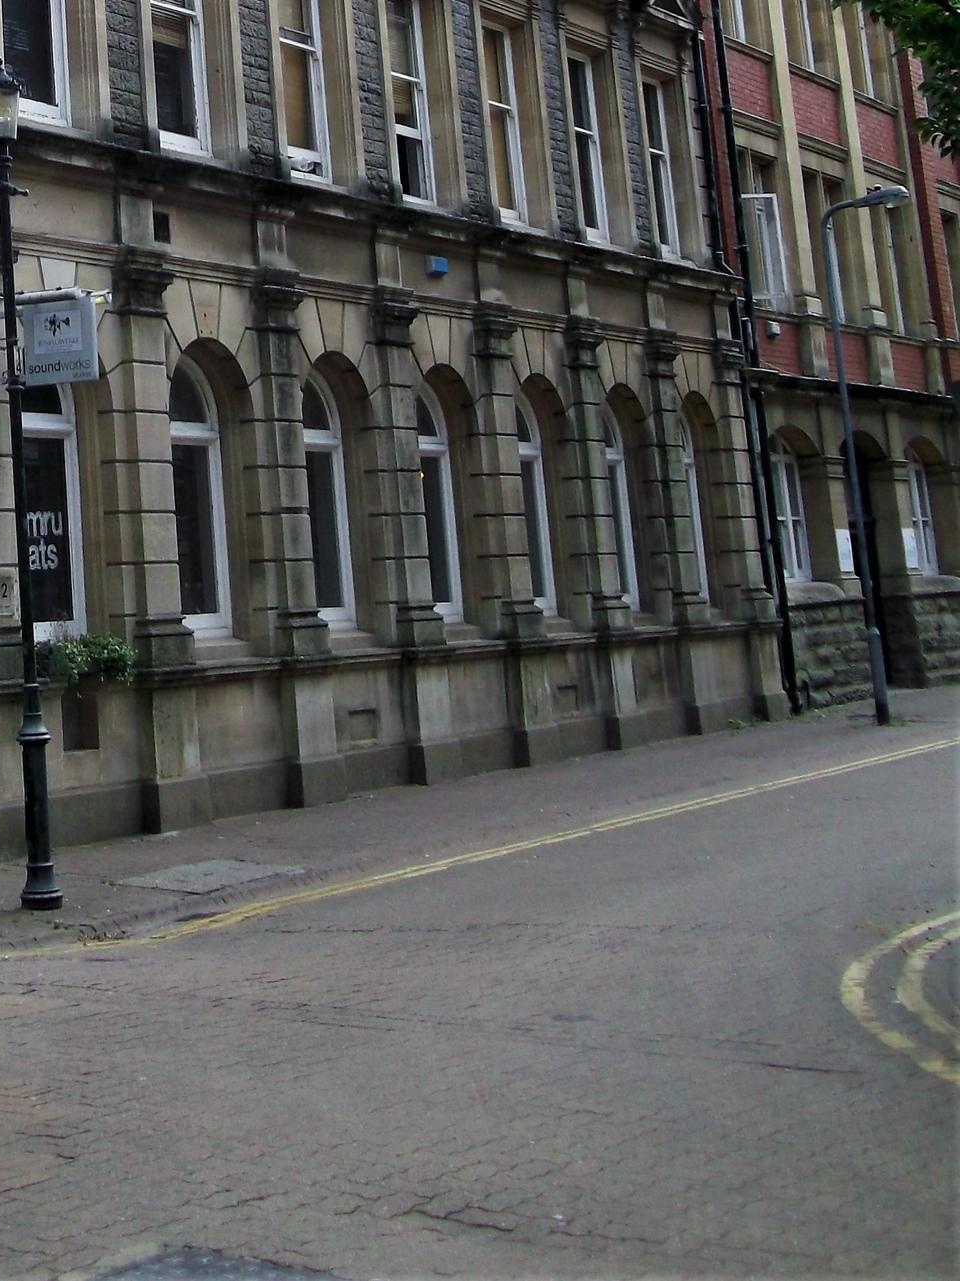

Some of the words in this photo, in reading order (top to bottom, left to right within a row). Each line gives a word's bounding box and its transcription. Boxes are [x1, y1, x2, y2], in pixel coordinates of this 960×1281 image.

[28, 358, 91, 375] soundworks
[23, 511, 63, 536] mru
[29, 538, 59, 570] ats
